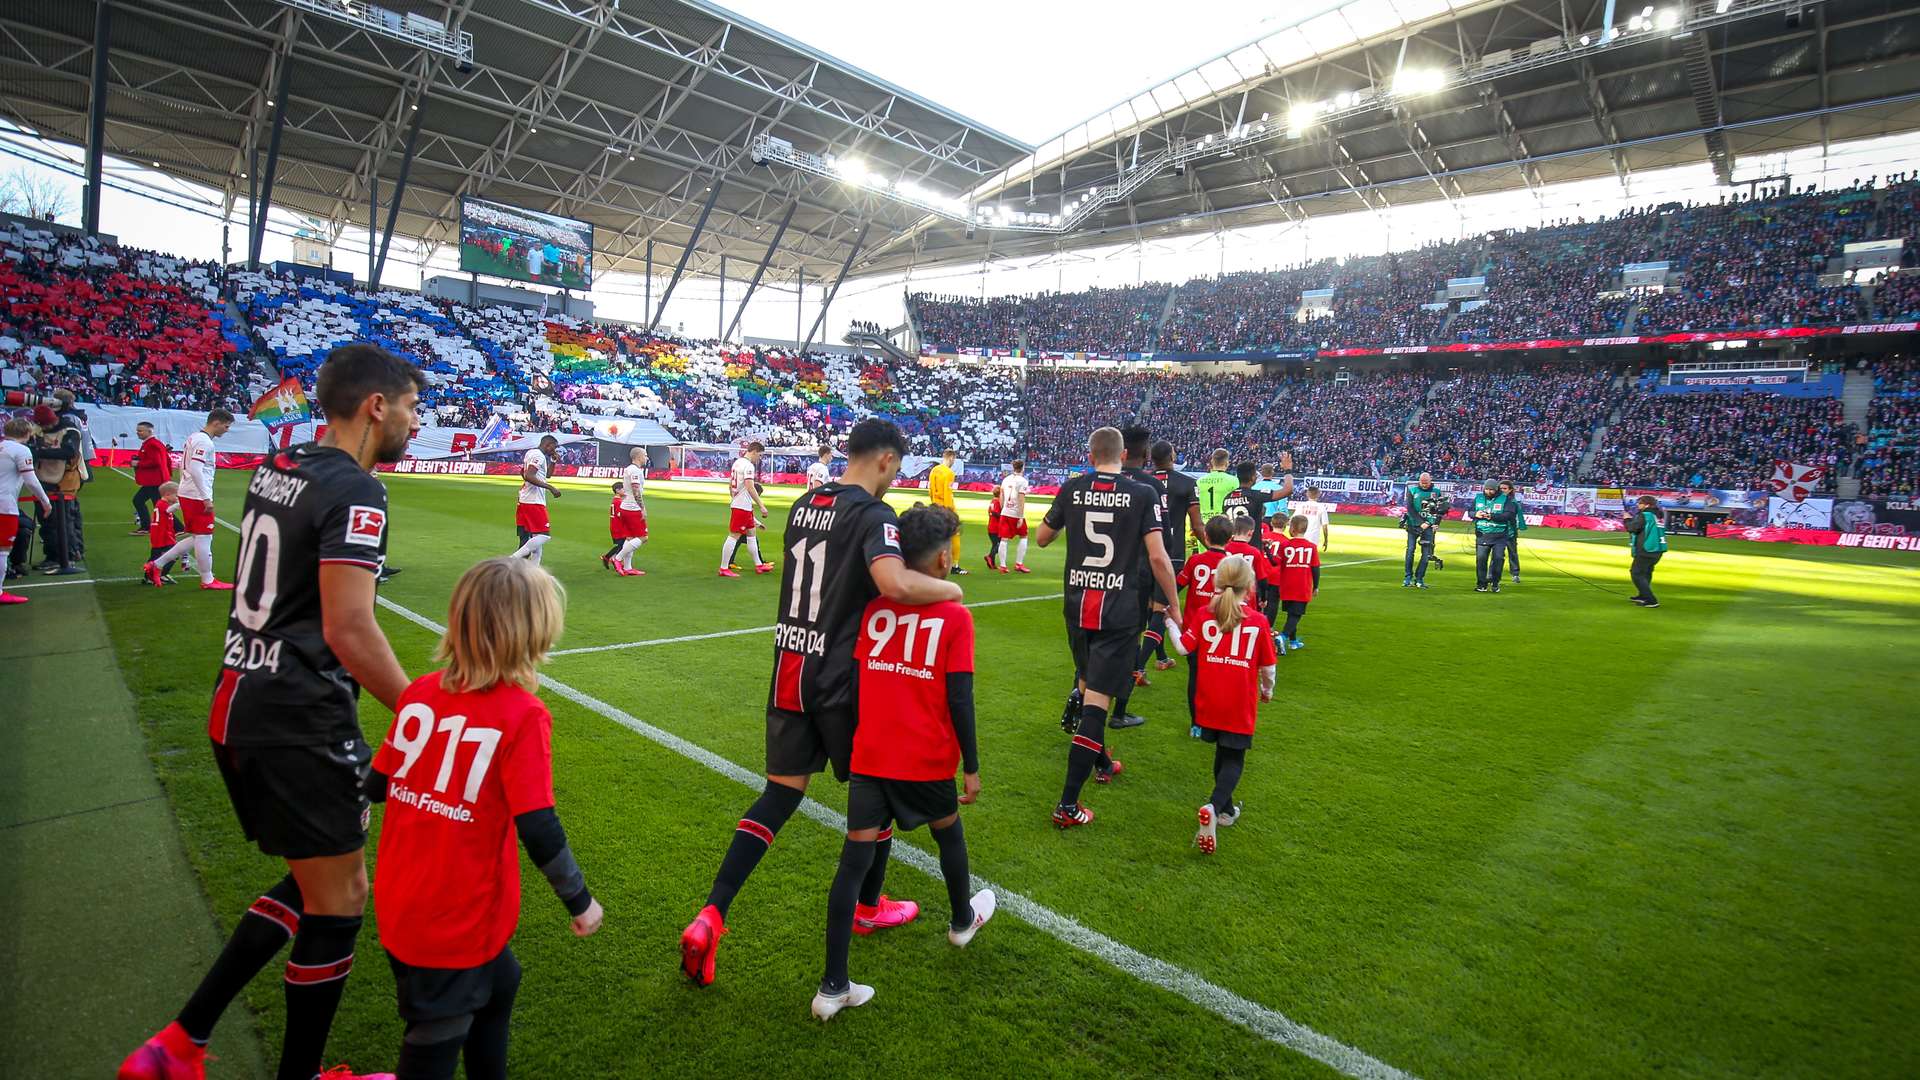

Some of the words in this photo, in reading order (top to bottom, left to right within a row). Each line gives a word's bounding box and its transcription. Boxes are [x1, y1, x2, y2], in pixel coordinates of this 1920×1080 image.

[395, 460, 415, 473] AUF
[415, 460, 448, 473] GEHT'S
[449, 461, 487, 474] LEIPZIG!
[577, 466, 593, 477] AUF
[593, 466, 619, 478] GEHT'S
[250, 466, 308, 507] EMIRBAY
[1305, 478, 1346, 490] Skatstadt
[1072, 490, 1083, 505] S.
[1084, 491, 1132, 508] BENDER
[792, 506, 837, 532] AMIRI
[1081, 510, 1115, 568] 5
[1836, 533, 1865, 547] AUF
[1862, 534, 1910, 550] GEHT'S
[1283, 546, 1313, 565] 911
[235, 508, 280, 632] 10
[790, 537, 828, 623] 11
[1069, 568, 1105, 589] BAYER
[1106, 572, 1125, 591] 04
[774, 622, 806, 651] AYER
[806, 628, 827, 657] 04
[867, 608, 945, 667] 911
[867, 658, 896, 673] kleine
